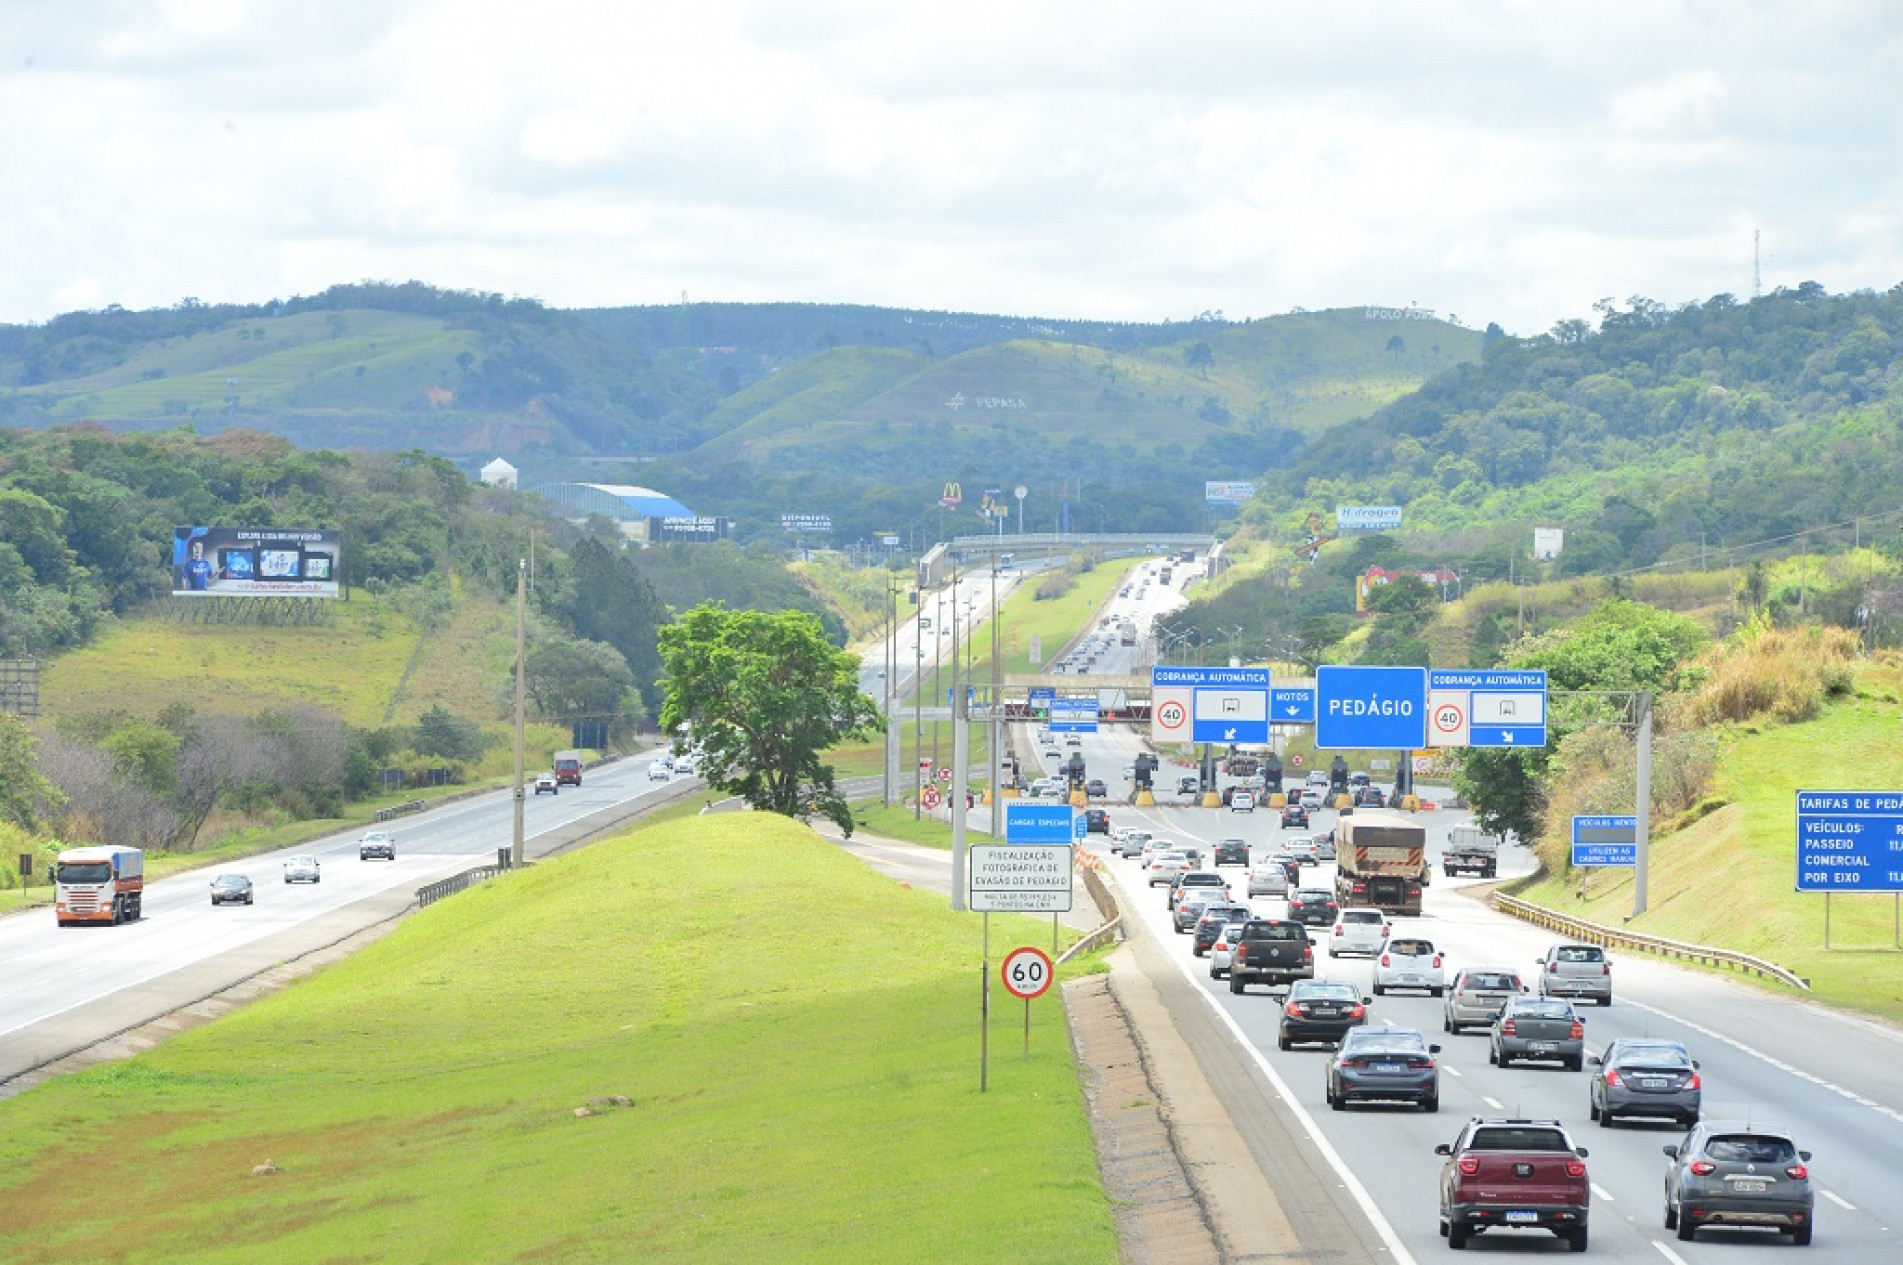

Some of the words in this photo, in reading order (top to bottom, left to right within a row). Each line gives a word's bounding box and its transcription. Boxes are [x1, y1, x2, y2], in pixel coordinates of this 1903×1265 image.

[1156, 672, 1205, 682] COBRANÇA
[1210, 671, 1266, 682] AUTOMÁTICA
[1433, 676, 1482, 686] COBRANÇA
[1486, 674, 1543, 685] AUTOMÁTICA
[1276, 693, 1309, 701] MOTOS
[1330, 693, 1413, 716] PEDÁGIO
[1163, 709, 1181, 720] 40
[1440, 713, 1457, 723] 40
[1801, 798, 1848, 808] TARIFAS
[1856, 799, 1870, 808] DE
[1805, 839, 1854, 849] PASSEIO
[987, 849, 1054, 862] FISCALIZAÇÃO
[1805, 856, 1870, 866] COMERCIAL
[1046, 864, 1059, 872] DE
[975, 875, 1011, 885] EVASÃO
[1012, 877, 1025, 885] DE
[1804, 873, 1828, 883] POR
[1833, 873, 1860, 883] EIXO
[1012, 962, 1042, 981] 60
